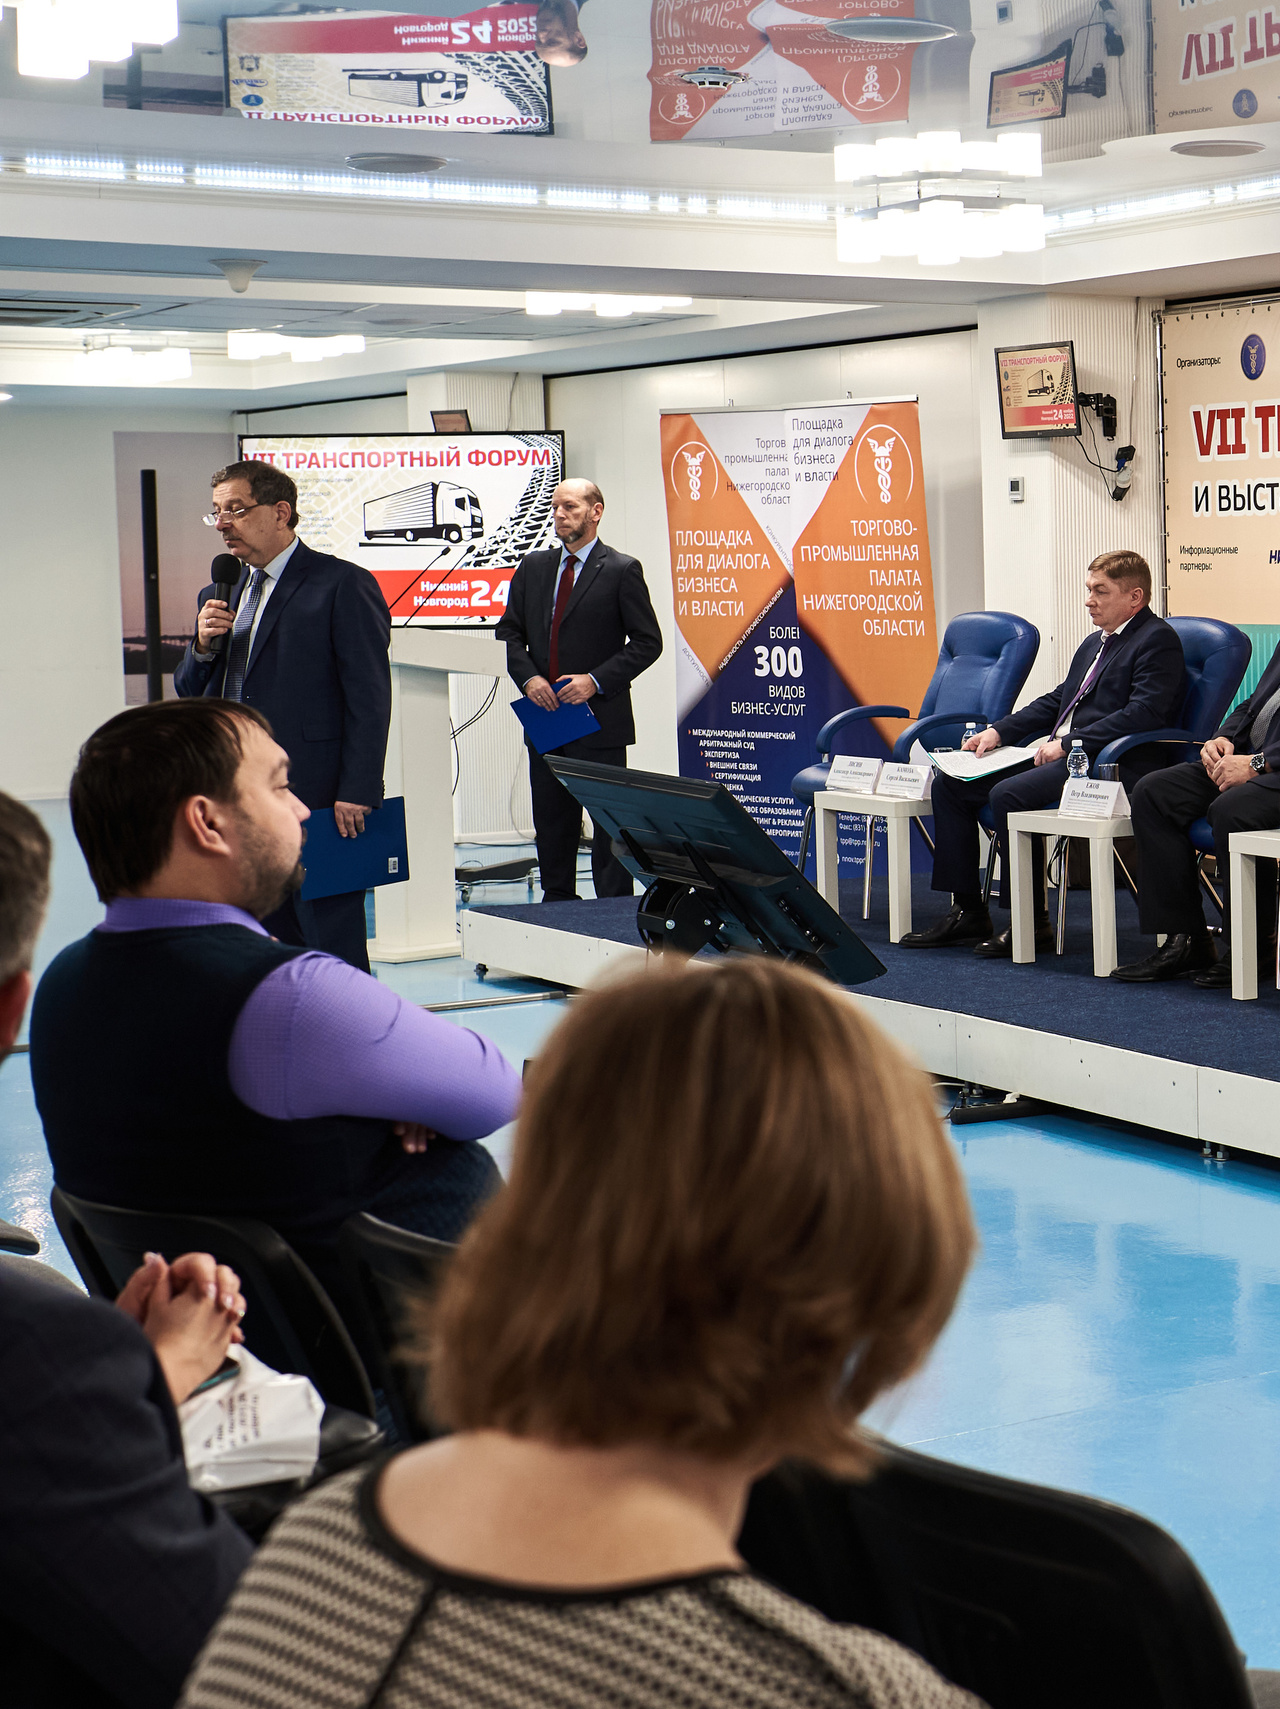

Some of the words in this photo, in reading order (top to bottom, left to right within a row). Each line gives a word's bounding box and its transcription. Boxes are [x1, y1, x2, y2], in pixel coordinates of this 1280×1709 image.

[1054, 410, 1063, 420] 24
[792, 418, 844, 432] Площадка
[1193, 406, 1247, 457] VII
[756, 438, 787, 450] Торгов
[792, 436, 811, 449] для
[814, 434, 854, 448] диалога
[282, 446, 460, 469] ТРАНСПОРТНЫЙ
[467, 448, 552, 466] ФОРУМ
[794, 452, 836, 466] бизнеса
[795, 472, 802, 482] и
[804, 470, 839, 482] власти
[1194, 484, 1210, 512] и
[850, 520, 918, 536] ТОРГОВО-
[676, 530, 754, 548] ПЛОЩАДКА
[801, 544, 920, 562] ПРОМЫШЛЕННАЯ
[1180, 544, 1238, 556] Информационные
[676, 554, 704, 572] ДЛЯ
[707, 554, 770, 572] ДИАЛОГА
[1180, 561, 1213, 572] партнеры:
[678, 577, 738, 593] БИЗНЕСА
[870, 570, 922, 586] ПАЛАТА
[420, 580, 469, 594] Нижний
[470, 580, 509, 607] 24
[414, 596, 469, 609] Новгород
[678, 601, 688, 616] И
[692, 600, 744, 616] ВЛАСТИ
[803, 591, 924, 614] НИЖЕГОРОДСКОЙ
[863, 620, 926, 636] ОБЛАСТИ
[754, 645, 804, 678] 300
[768, 685, 806, 700] ВИДОВ
[731, 702, 806, 716] БИЗНЕС-УСЛУГ
[692, 728, 746, 738] МЕЖДУНАРОДНЫЙ
[747, 731, 796, 740] КОММЕРЧЕСКИЙ
[699, 740, 742, 748] АРБИТРАЖНЫЙ
[743, 742, 756, 750] СУД
[704, 750, 740, 759] ЭКСПЕРТИЗА
[710, 762, 738, 770] ВНЕШНИЕ
[738, 762, 758, 770] СВЯЗИ
[715, 772, 762, 782] СЕРТИФИКАЦИЯ
[771, 797, 794, 805] УСЛУГИ
[759, 806, 802, 816] ОБРАЗОВАНИЕ
[778, 819, 804, 827] РЕКЛАМА
